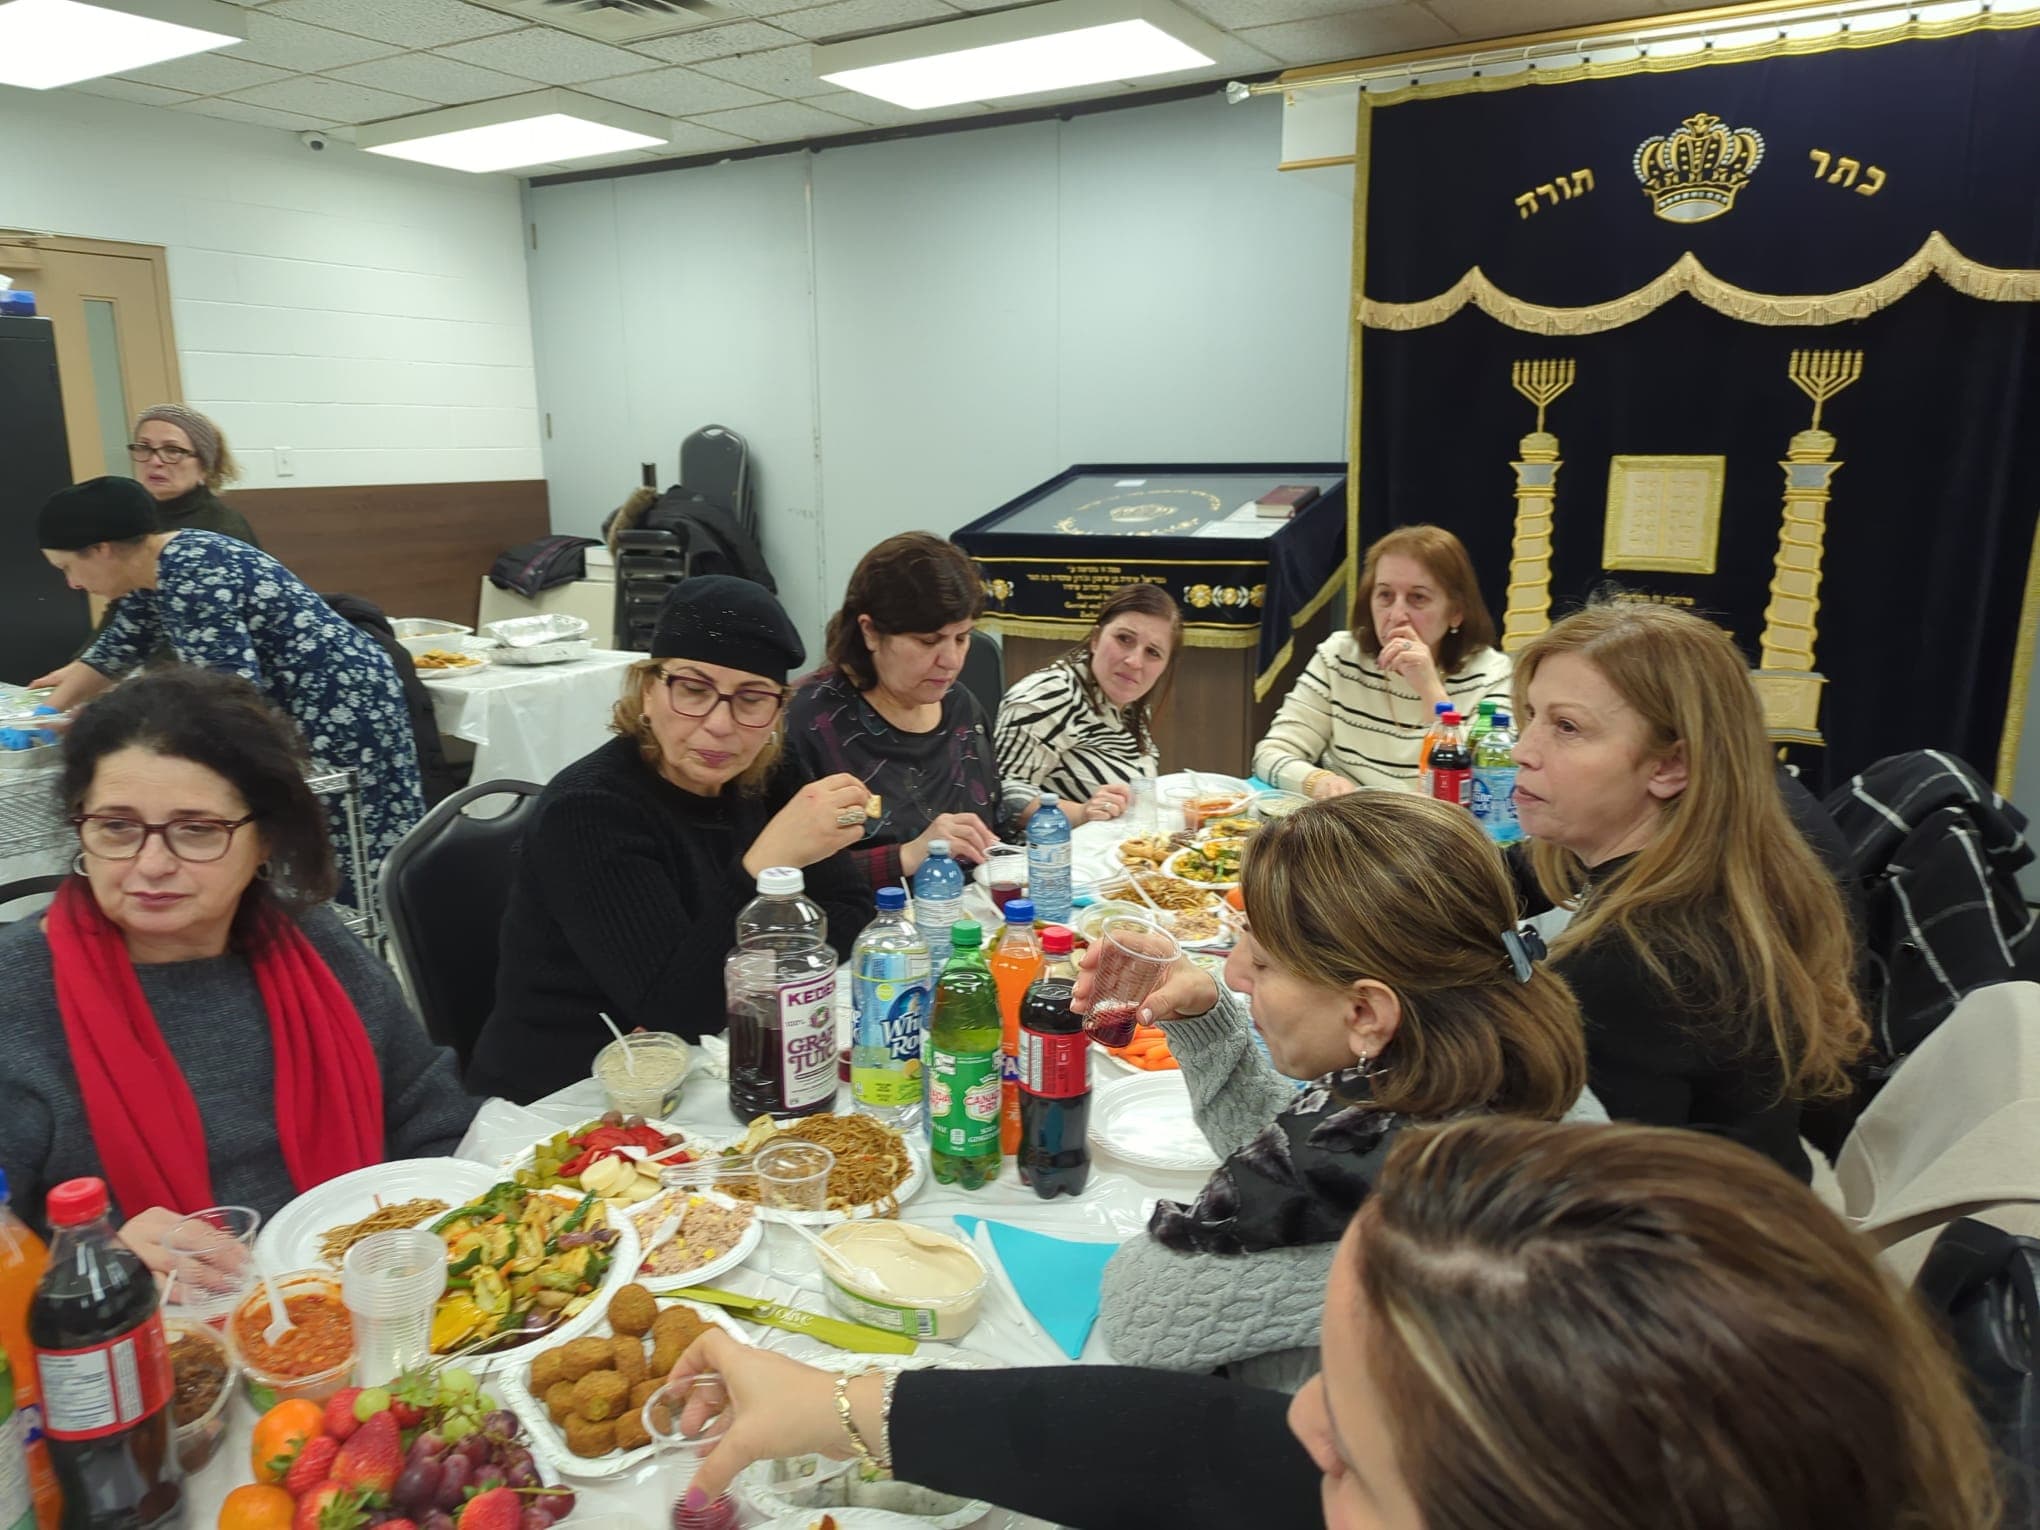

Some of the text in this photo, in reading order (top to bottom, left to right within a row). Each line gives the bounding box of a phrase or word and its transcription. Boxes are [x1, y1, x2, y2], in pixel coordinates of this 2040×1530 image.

[1514, 148, 1886, 220] כתר תורה
[787, 981, 836, 1007] KEDE
